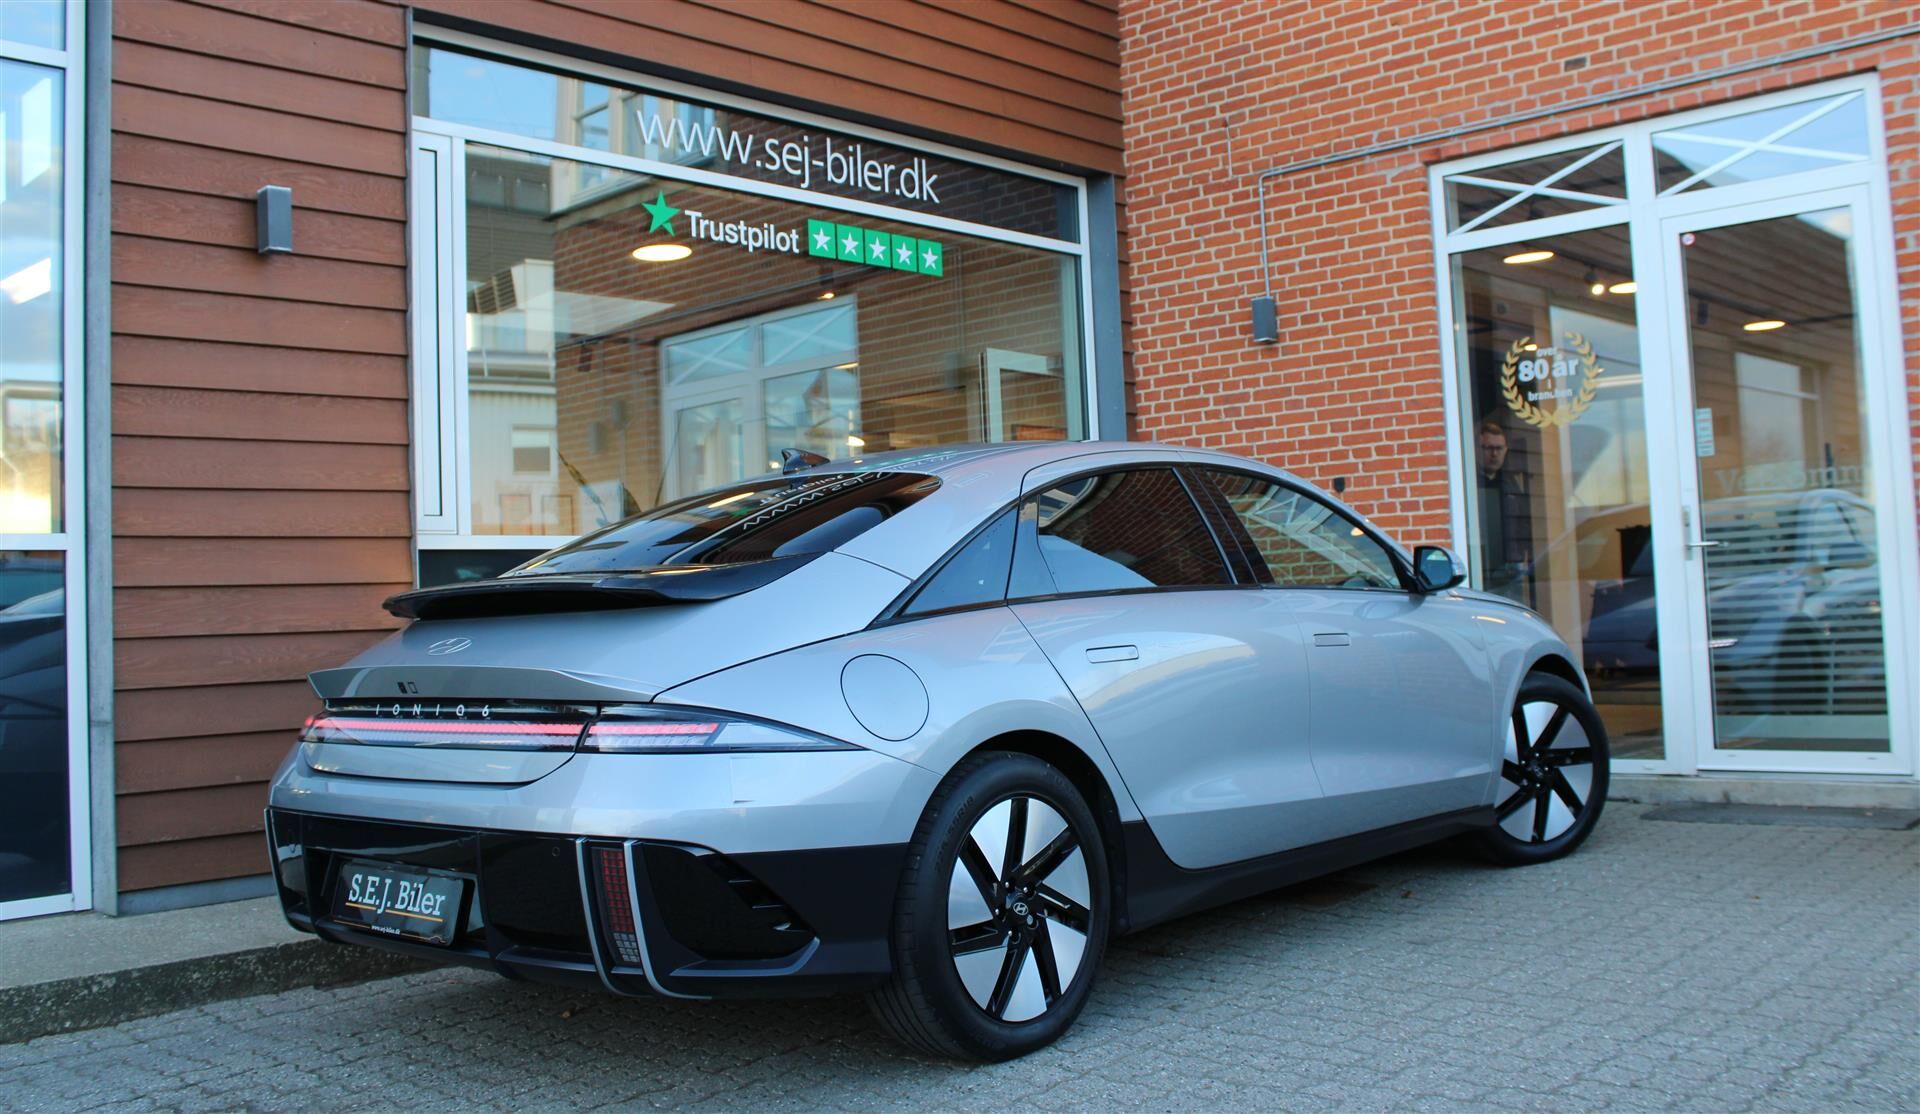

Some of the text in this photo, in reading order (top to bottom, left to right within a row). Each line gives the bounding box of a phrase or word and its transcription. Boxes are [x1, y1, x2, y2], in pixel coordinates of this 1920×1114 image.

[636, 110, 940, 204] www.sej-biler.dk
[684, 209, 800, 253] Trustpilot
[1518, 358, 1549, 383] 80
[348, 873, 446, 916] S.E.J. Biler
